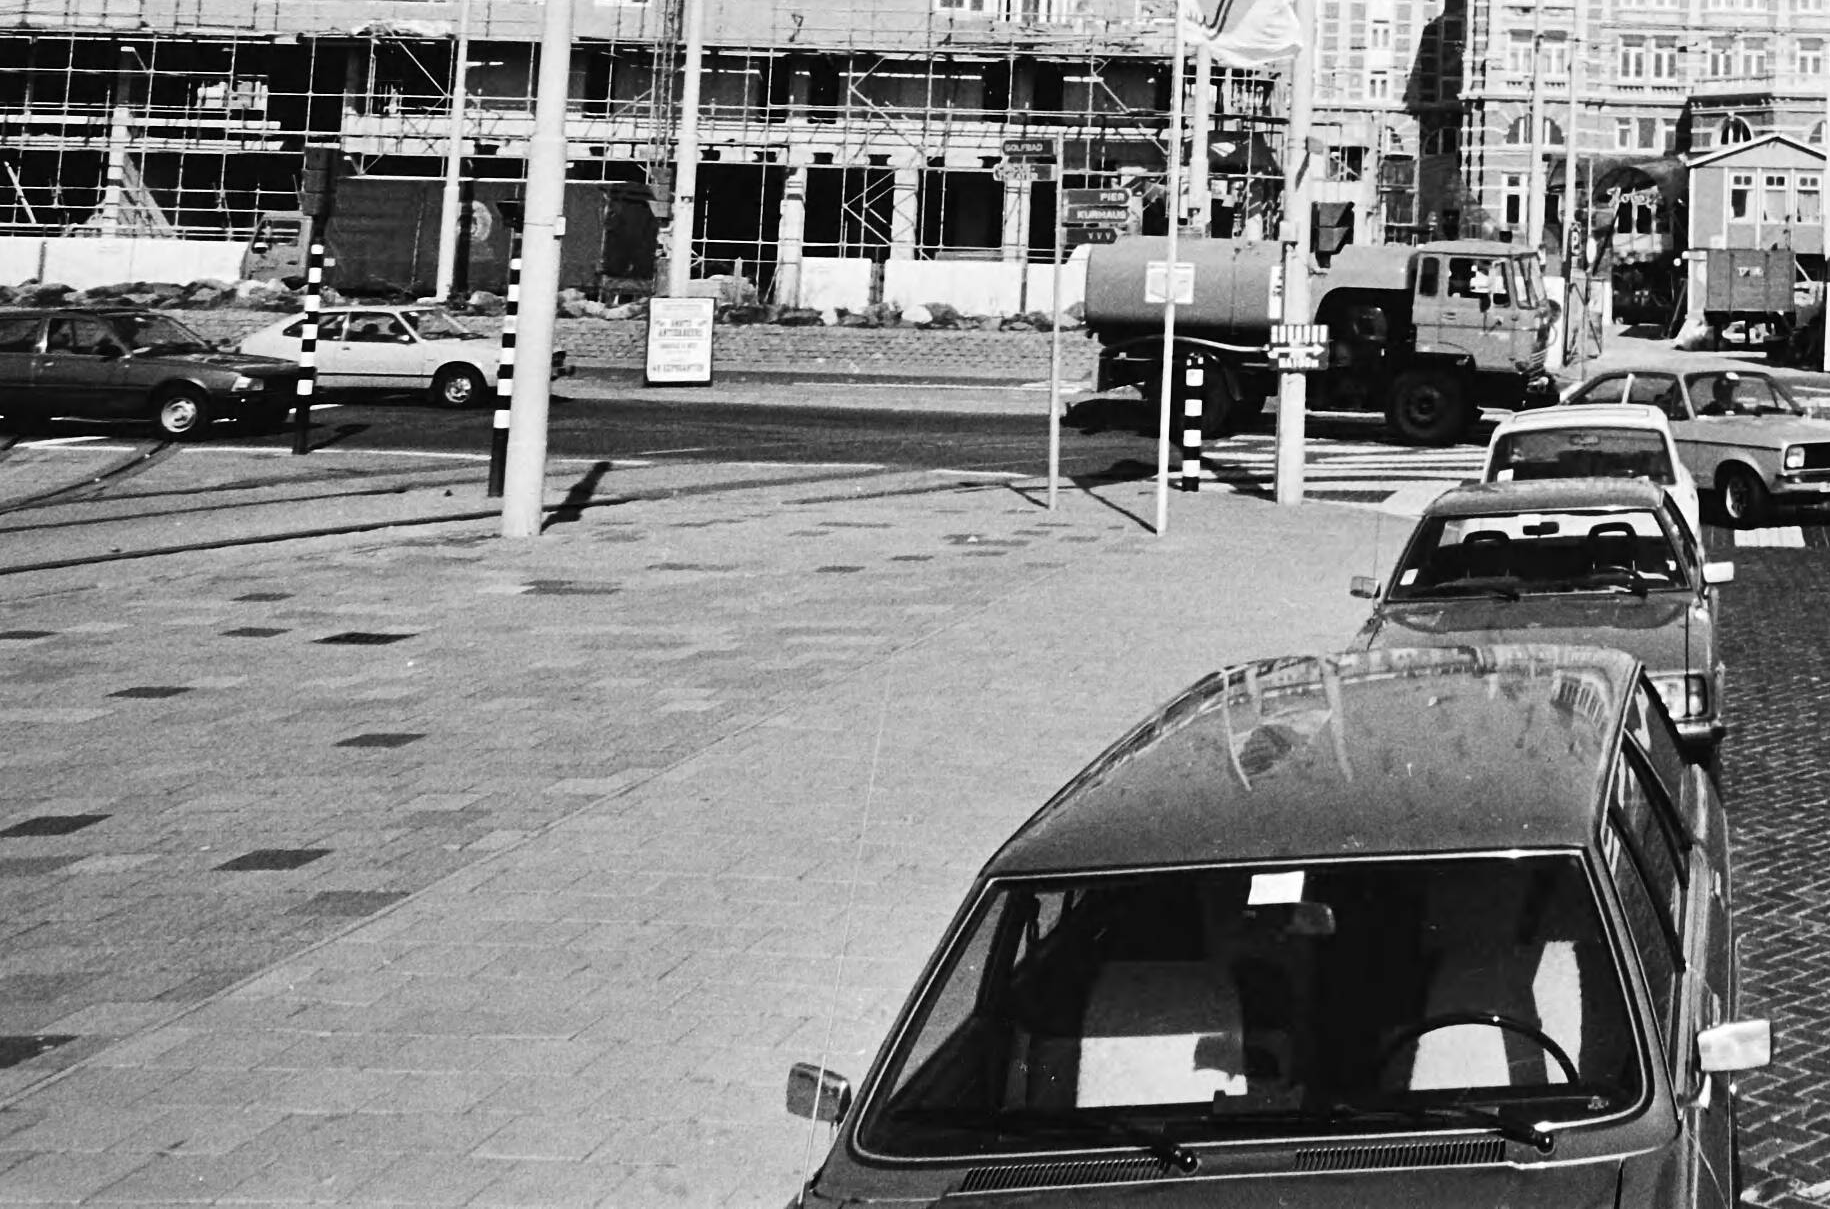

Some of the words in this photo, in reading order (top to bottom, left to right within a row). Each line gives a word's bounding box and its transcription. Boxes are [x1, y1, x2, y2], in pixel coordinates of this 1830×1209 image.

[1004, 143, 1043, 152] GOLFBAD
[1100, 192, 1125, 202] PIER
[1077, 210, 1127, 220] KURHAUS
